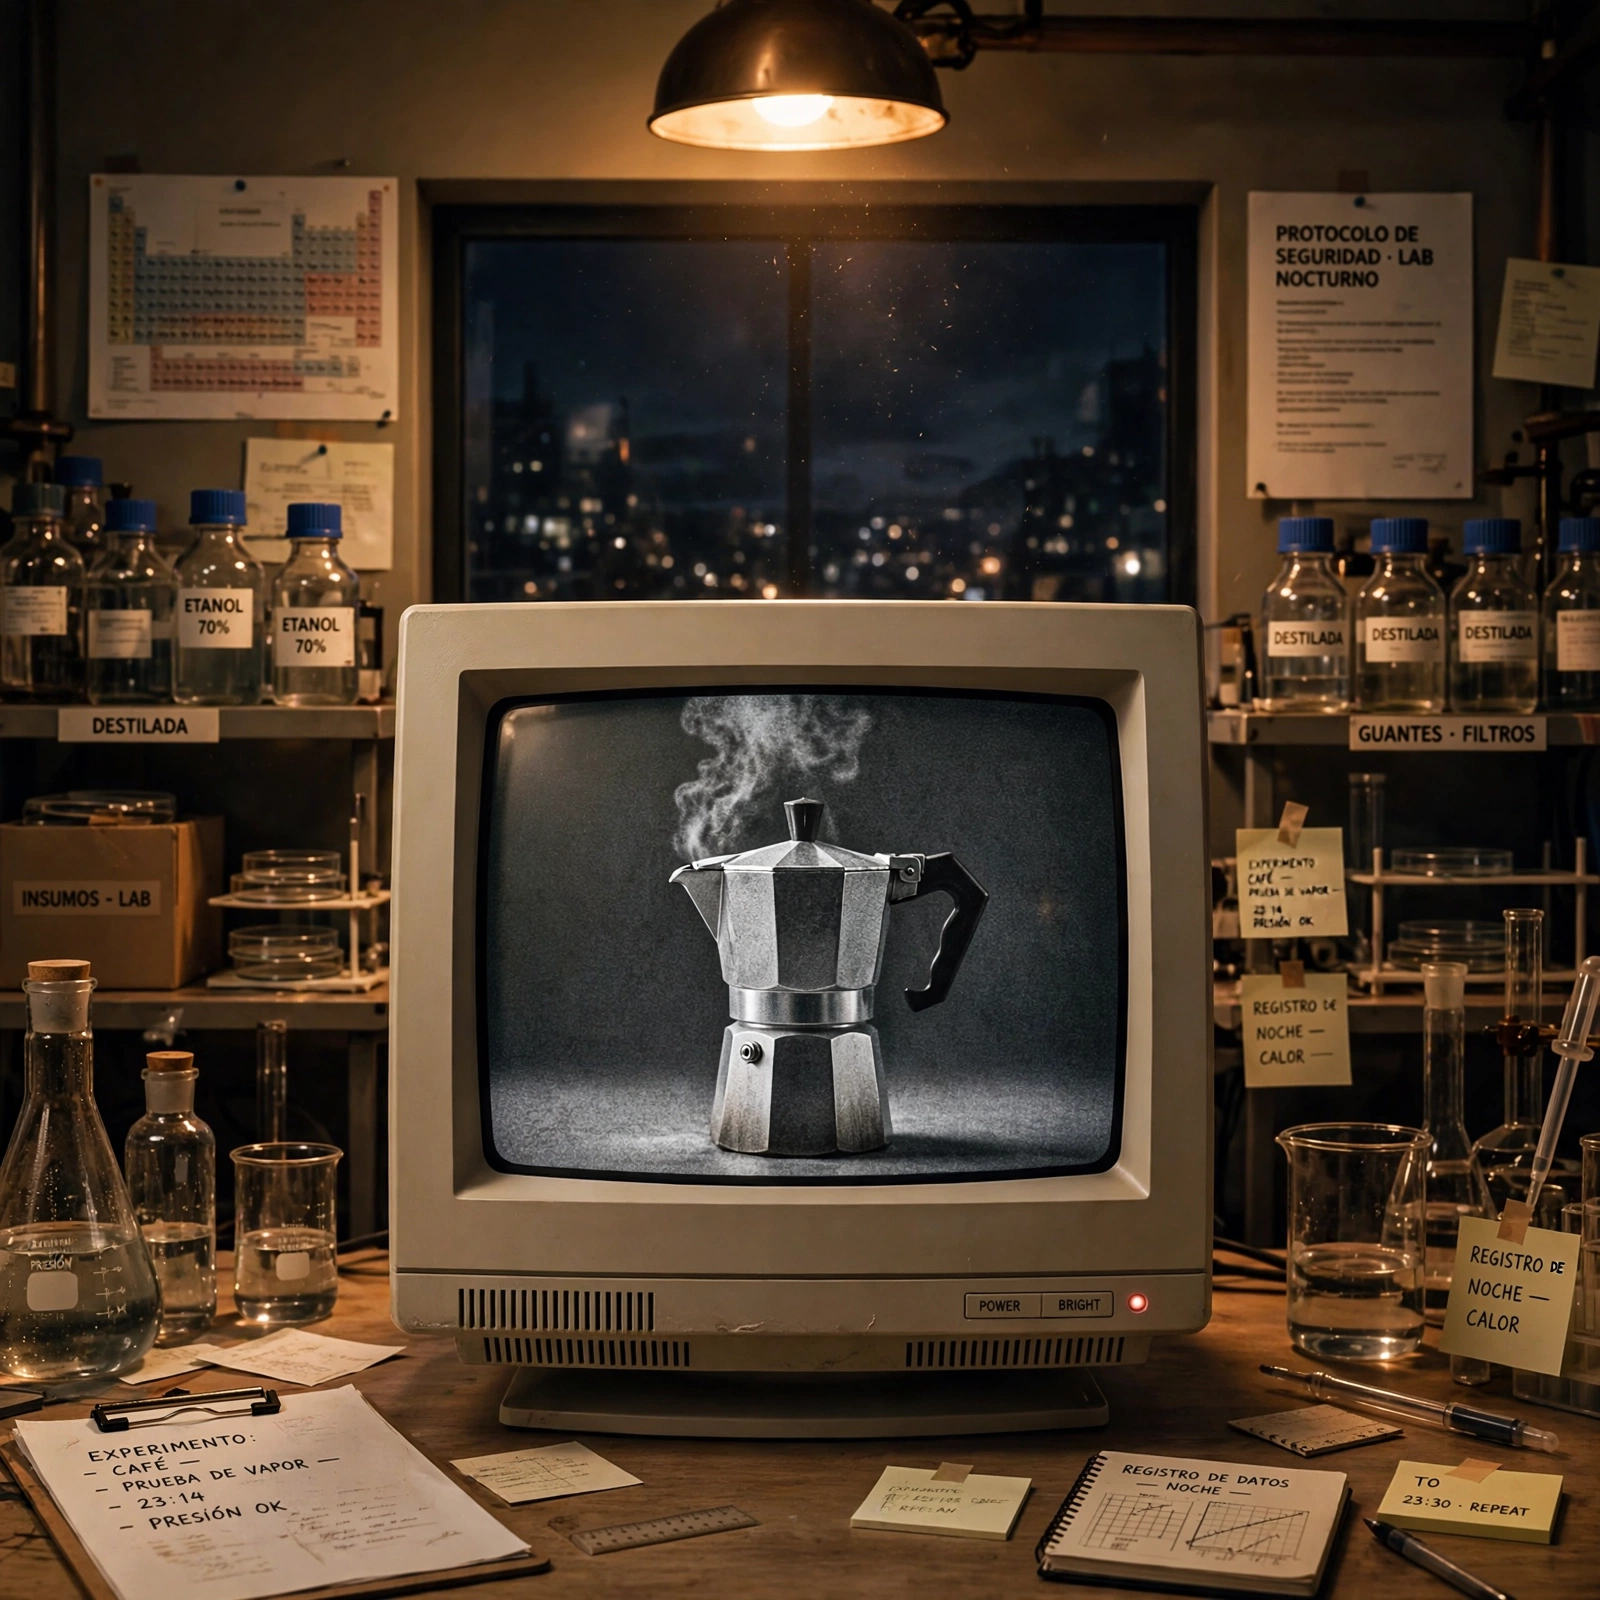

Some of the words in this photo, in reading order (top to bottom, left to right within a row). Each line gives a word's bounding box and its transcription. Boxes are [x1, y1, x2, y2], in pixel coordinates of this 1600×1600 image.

[1276, 224, 1390, 243] PROTOCOLO
[1394, 225, 1419, 243] DE
[1276, 247, 1382, 266] SEGURIDAD
[1398, 248, 1434, 266] LAB
[1276, 270, 1380, 288] NOCTURNO
[183, 597, 243, 614] ETANOL
[197, 619, 230, 635] 70%
[281, 616, 340, 633] ETANOL
[1465, 626, 1533, 640] DESTILADA
[1274, 631, 1343, 646] DESTILADA
[1372, 627, 1440, 642] DESTILADA
[295, 638, 326, 654] 70%
[92, 717, 188, 735] DESTILADA
[1358, 724, 1443, 743] GUANTES
[1462, 724, 1536, 744] FILTROS
[22, 890, 100, 908] INSUMOS
[118, 890, 151, 908] LAB
[1298, 916, 1314, 926] OK
[1253, 998, 1318, 1015] REGISTRO
[1256, 1024, 1303, 1040] NOCHE
[1259, 1048, 1305, 1066] CALOR
[1469, 1245, 1544, 1273] REGISTRO
[1549, 1260, 1566, 1275] DE
[1467, 1277, 1524, 1303] NOCHE
[979, 1299, 1021, 1312] POWER
[1058, 1298, 1101, 1311] BRIGHT
[1466, 1308, 1520, 1334] CALOR
[88, 1433, 256, 1463] EXPERIMENTO:
[112, 1457, 169, 1477] CAFÉ
[122, 1474, 201, 1493] PRUEBA
[209, 1467, 236, 1481] DE
[243, 1458, 310, 1476] VAPOR
[1122, 1464, 1200, 1480] REGISTRO
[1207, 1472, 1229, 1483] DE
[1236, 1475, 1289, 1488] DATOS
[1166, 1482, 1222, 1496] NOCHE
[1414, 1475, 1440, 1488] TO
[137, 1490, 205, 1511] 23:14
[255, 1500, 287, 1514] OK
[1402, 1494, 1452, 1509] 23:30
[1469, 1502, 1530, 1517] REPEAT
